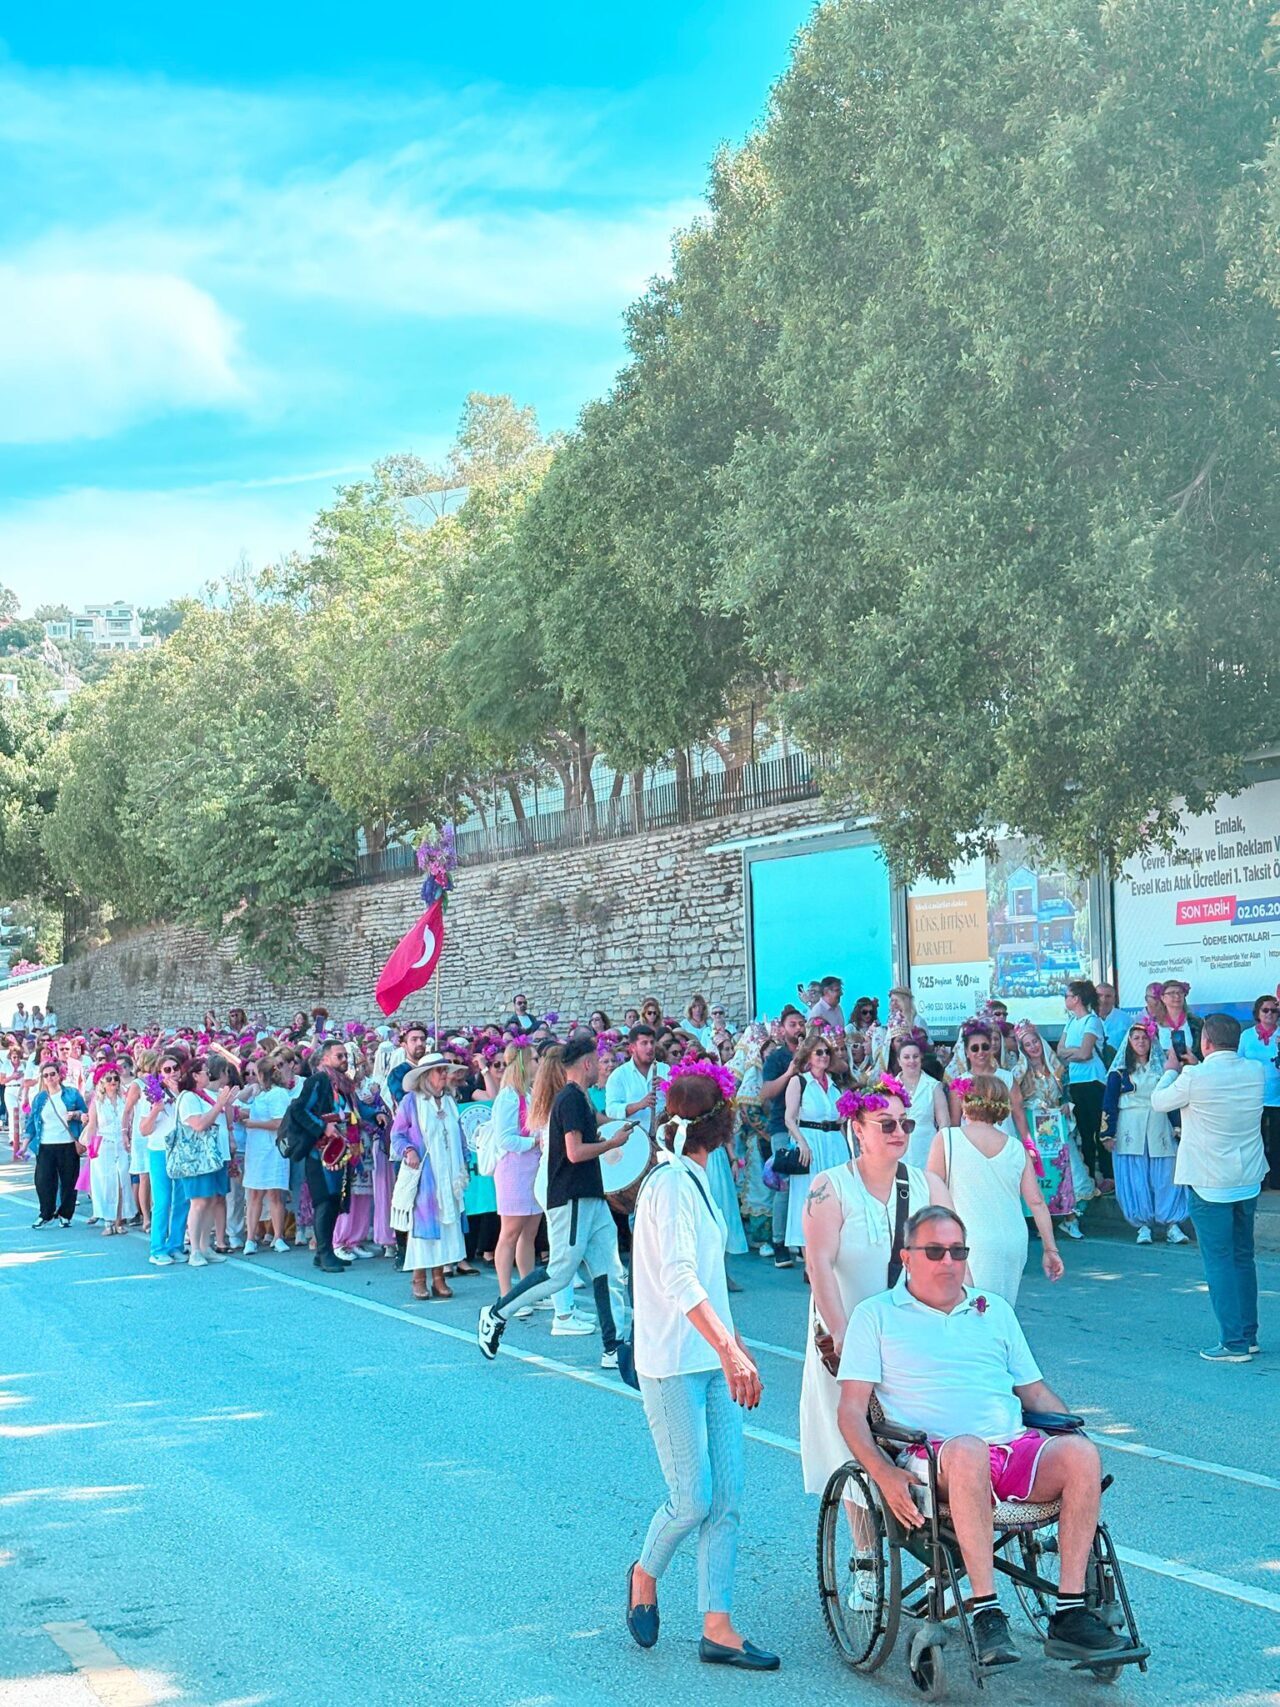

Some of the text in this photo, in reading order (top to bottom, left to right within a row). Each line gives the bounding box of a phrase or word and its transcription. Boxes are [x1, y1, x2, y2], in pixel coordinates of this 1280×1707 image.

[1215, 816, 1246, 835] Emlak,
[1141, 852, 1166, 873] Çevre
[1205, 849, 1217, 862] ve
[1218, 841, 1235, 861] İlan
[1237, 838, 1273, 857] Reklam
[1131, 879, 1154, 896] Evsel
[1155, 877, 1173, 893] Katı
[1174, 873, 1192, 891] Atık
[1193, 869, 1232, 889] Ücretleri
[1234, 867, 1242, 883] 1.
[1243, 864, 1272, 882] Taksit
[1181, 901, 1230, 919] SON TARİH
[915, 914, 940, 932] LÜKS,
[1203, 931, 1270, 946] ÖDEME NOKTALARI
[917, 976, 934, 989] %25
[956, 974, 969, 987] %0
[970, 976, 980, 985] Faiz
